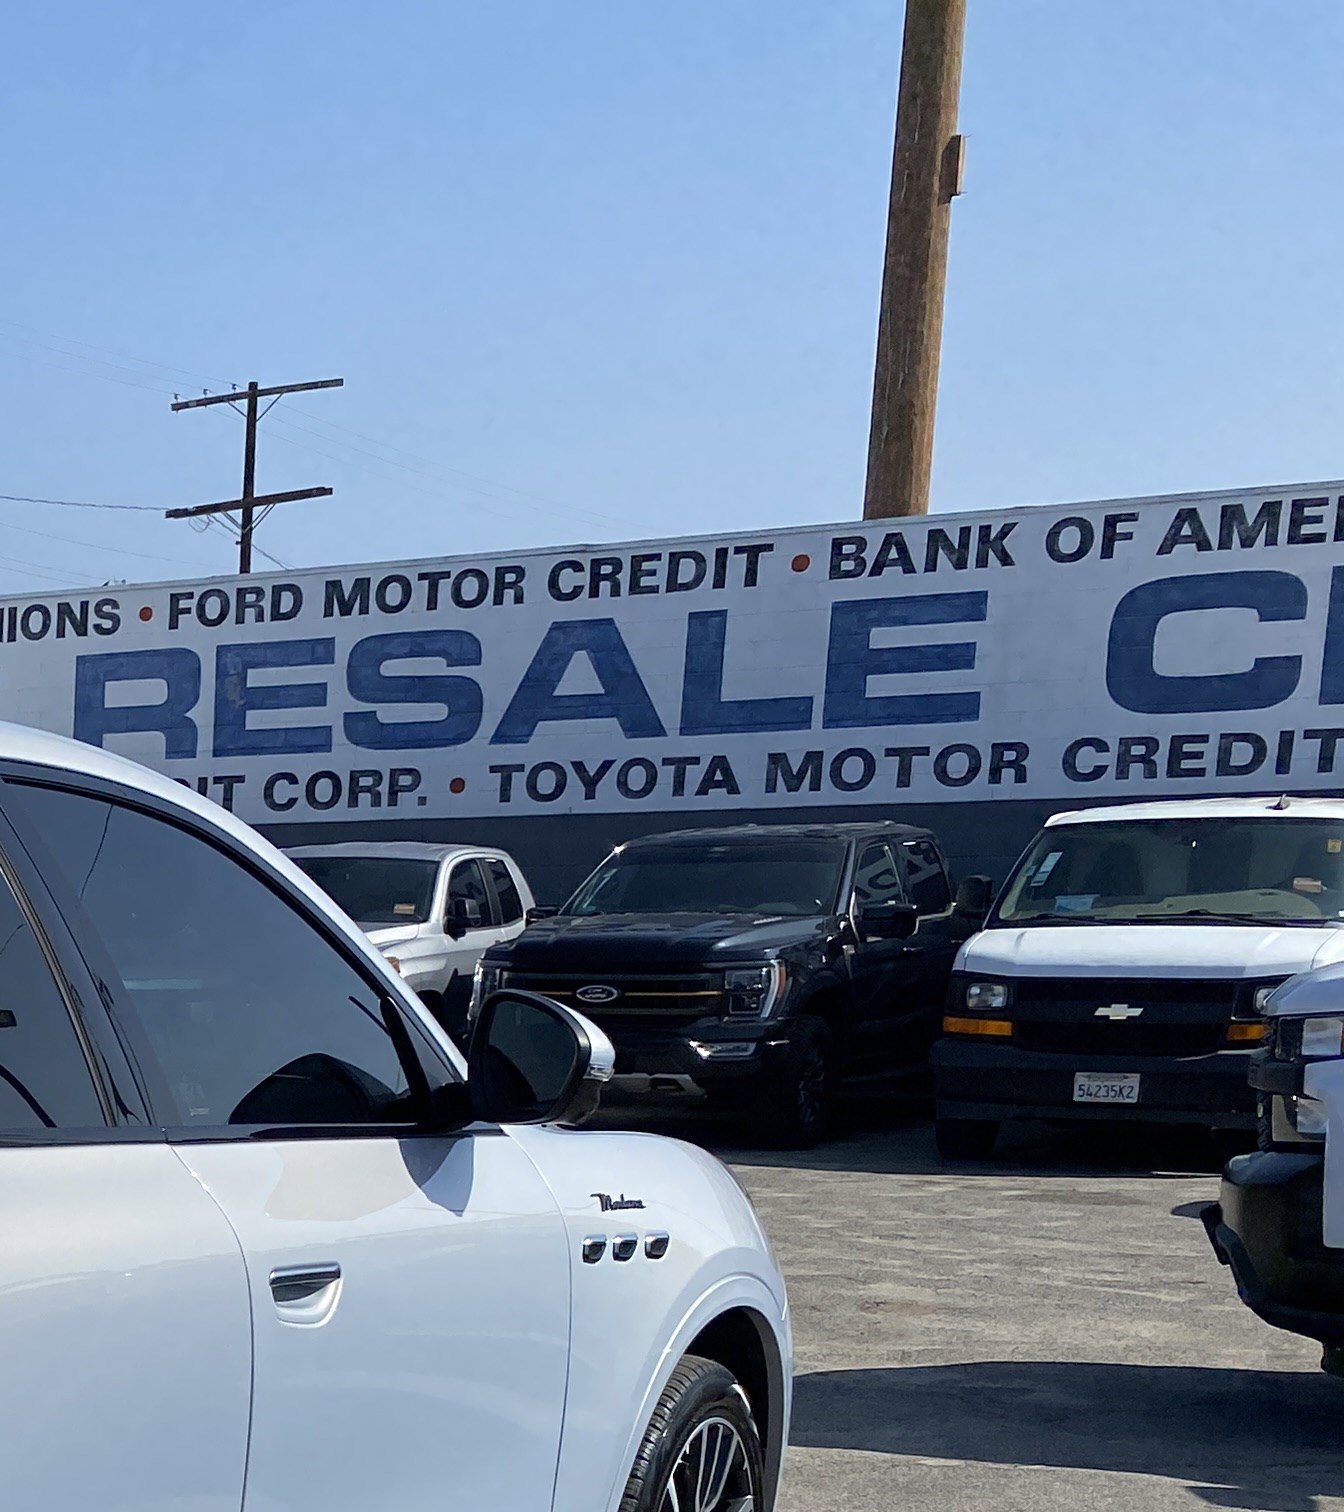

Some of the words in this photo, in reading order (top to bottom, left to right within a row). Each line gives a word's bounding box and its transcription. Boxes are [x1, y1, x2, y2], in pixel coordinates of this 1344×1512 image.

[828, 521, 1020, 581] BANK
[1045, 511, 1141, 564] OF
[1155, 495, 1344, 556] AME
[167, 581, 304, 632] FORD
[323, 564, 526, 618] MOTOR
[547, 542, 775, 603] CREDIT
[72, 589, 989, 760] RESALE
[1105, 564, 1344, 717] C
[263, 767, 427, 812] CORP.
[488, 753, 742, 804] TOYOTA
[764, 741, 1030, 795] MOTOR
[1062, 727, 1344, 784] CREDIT
[1078, 1083, 1135, 1100] 54235K2
